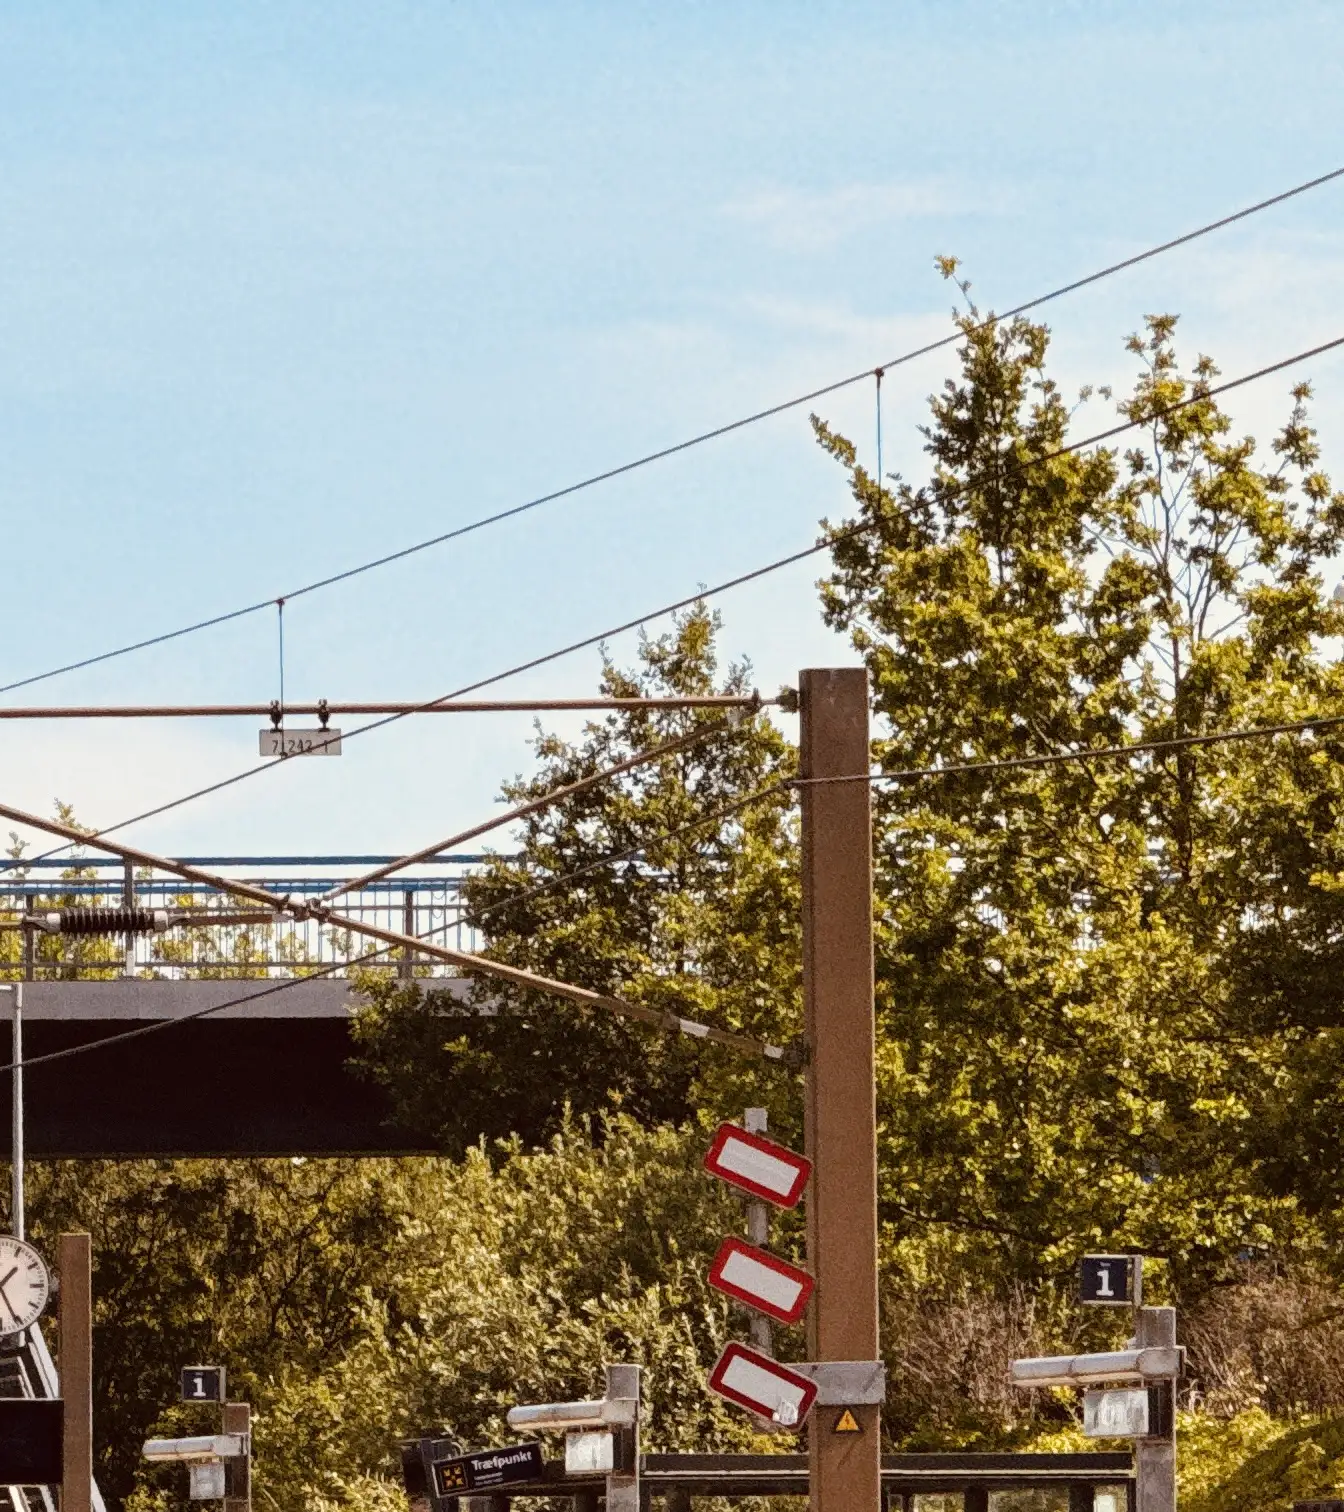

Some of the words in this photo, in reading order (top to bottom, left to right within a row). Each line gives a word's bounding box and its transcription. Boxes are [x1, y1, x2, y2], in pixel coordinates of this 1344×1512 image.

[1096, 1269, 1114, 1296] 1
[193, 1377, 206, 1396] 1
[471, 1450, 532, 1470] Træfpunkt
